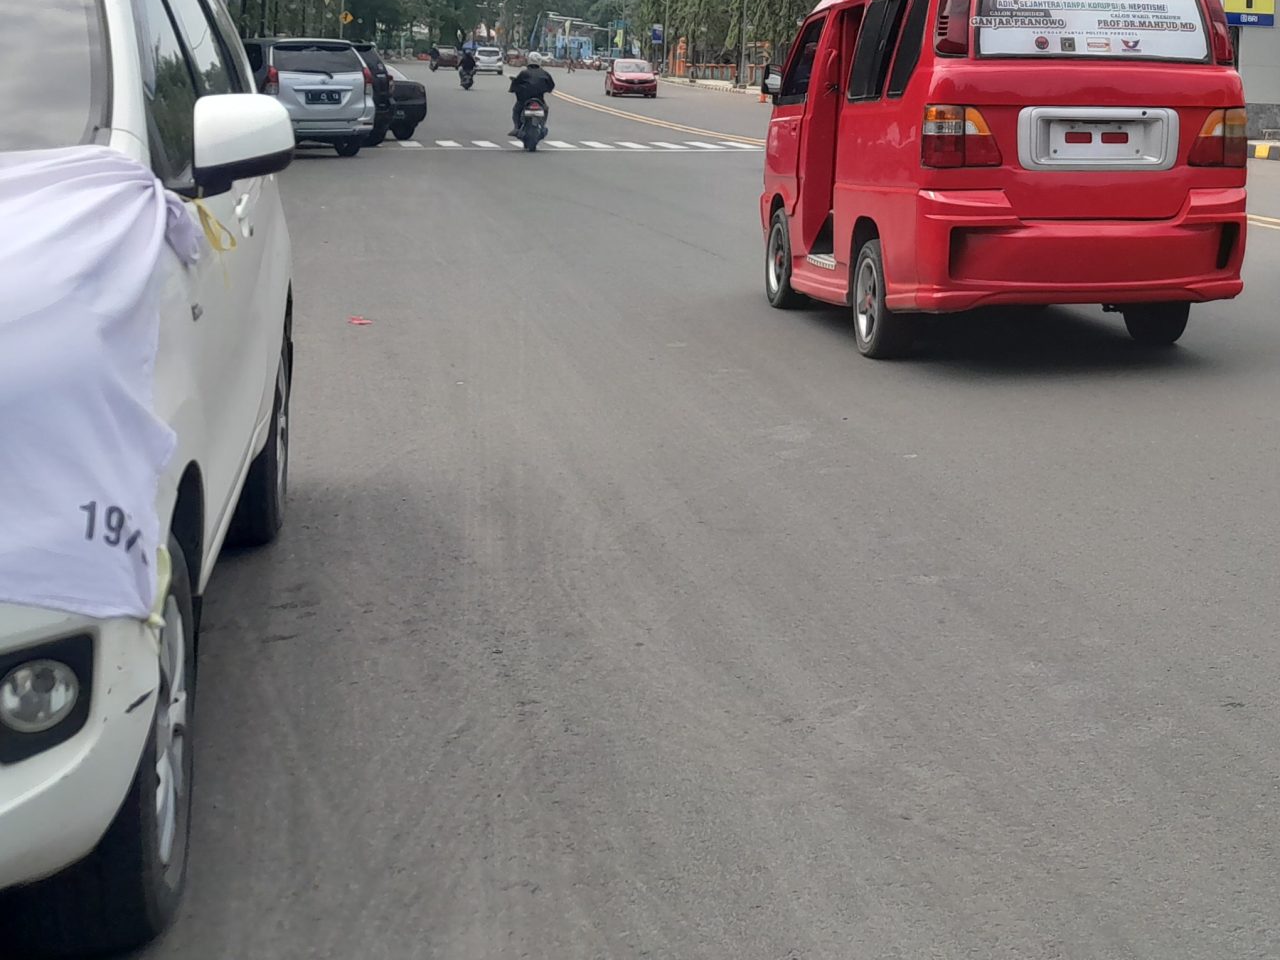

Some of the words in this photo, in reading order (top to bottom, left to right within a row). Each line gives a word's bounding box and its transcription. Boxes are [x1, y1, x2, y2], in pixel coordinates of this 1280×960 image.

[1063, 1, 1086, 9] TANPA
[1128, 3, 1167, 11] NEPOTISME
[971, 18, 1012, 27] GANJAR
[1014, 18, 1065, 27] PRANOWO
[1180, 22, 1195, 30] MD
